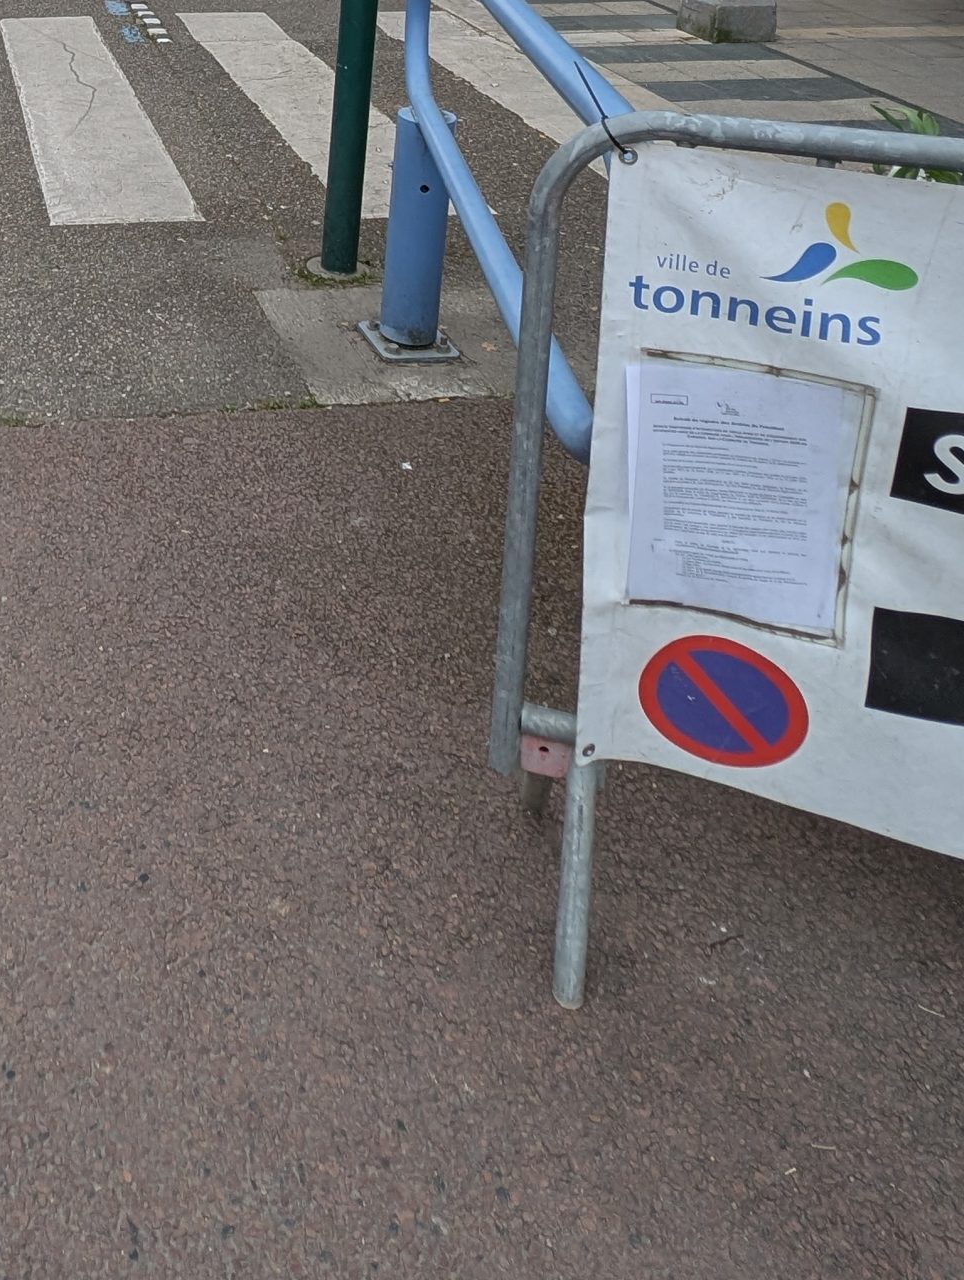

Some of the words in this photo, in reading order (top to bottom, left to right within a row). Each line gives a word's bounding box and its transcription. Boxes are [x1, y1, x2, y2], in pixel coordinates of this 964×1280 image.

[656, 253, 700, 274] ville
[705, 260, 732, 280] de
[628, 275, 882, 347] tonneins
